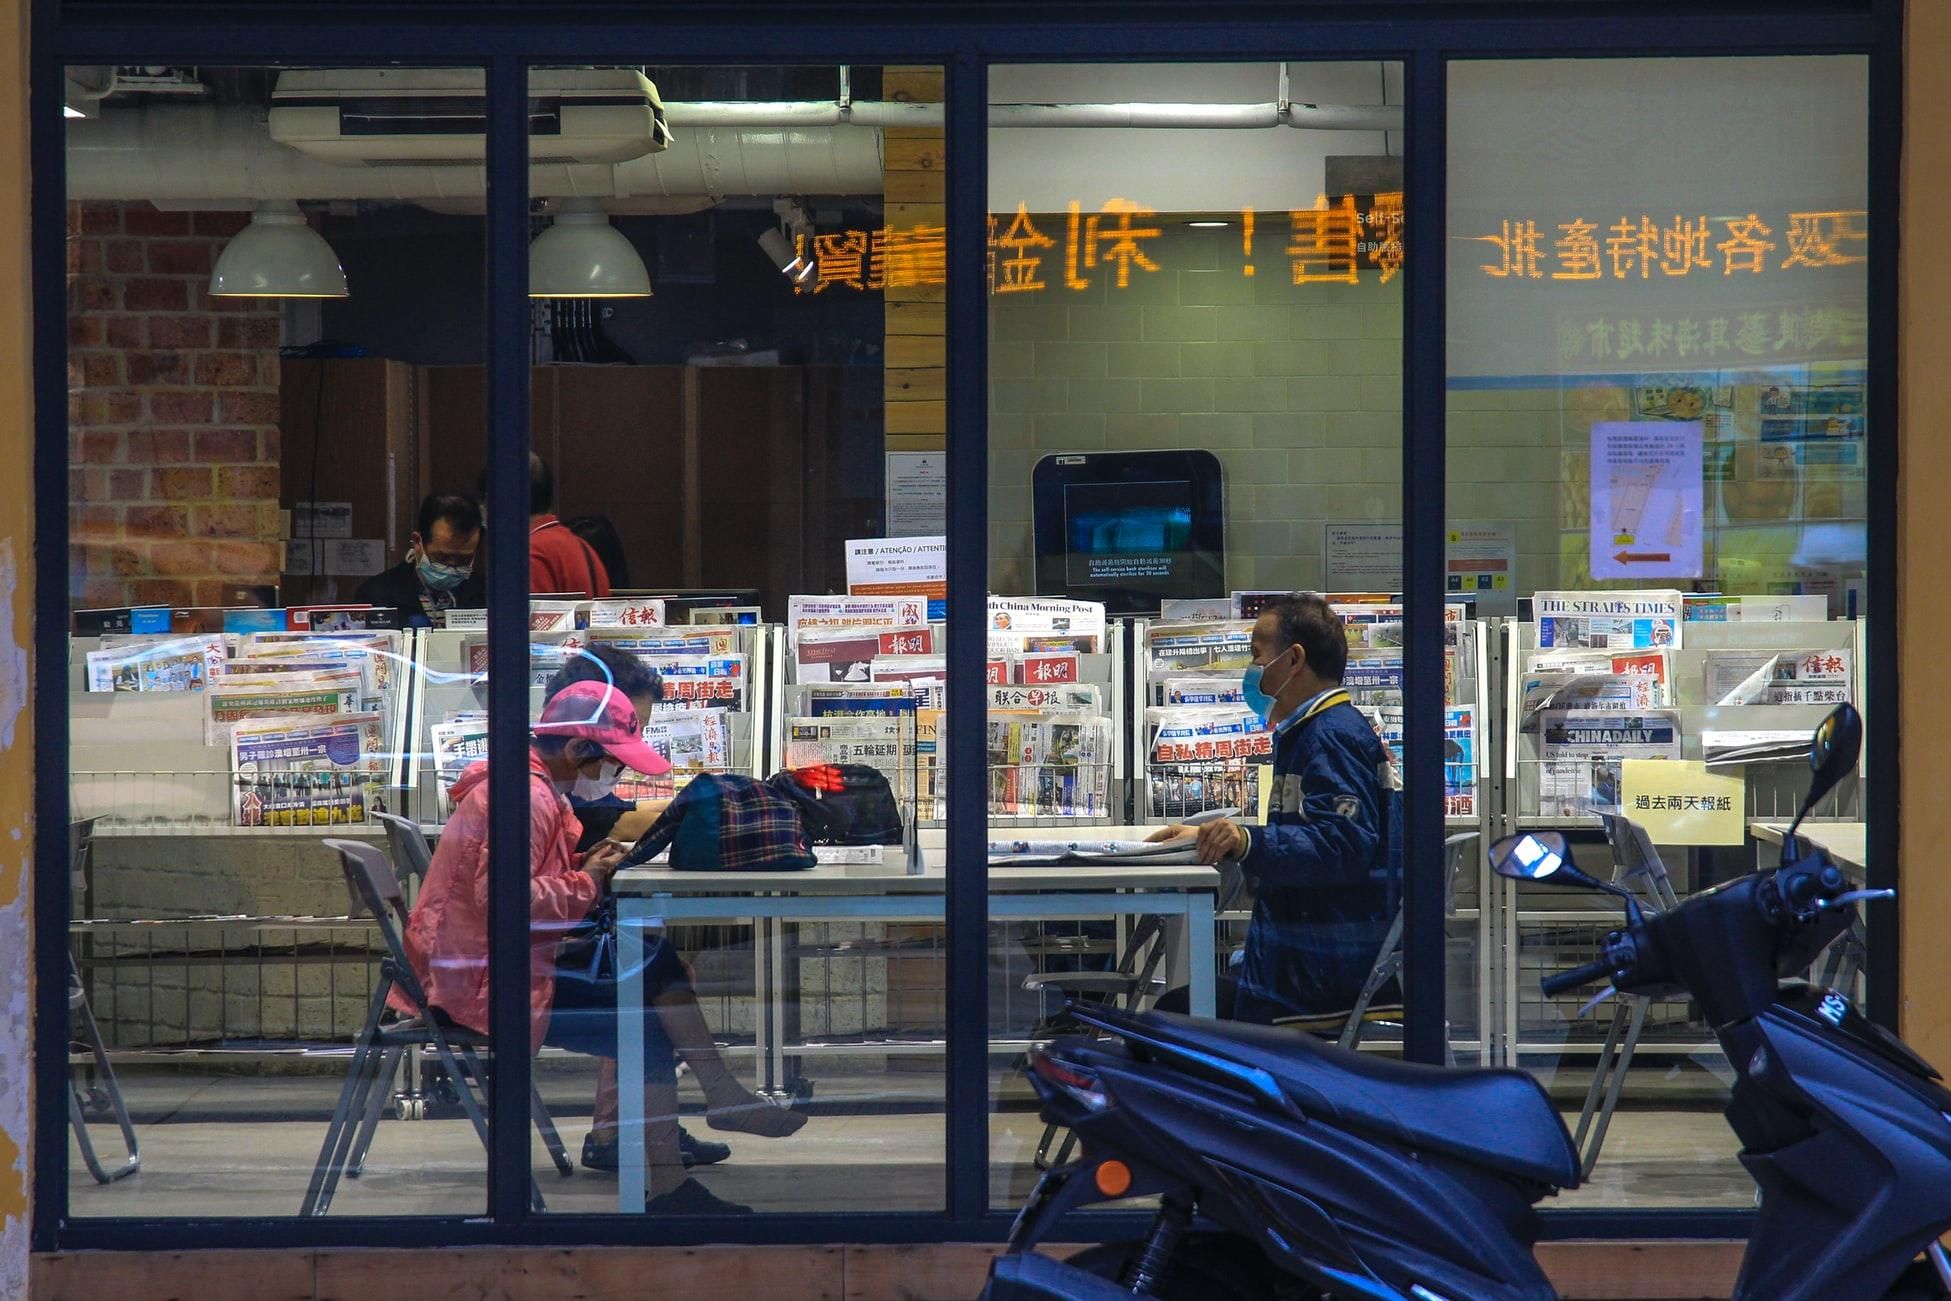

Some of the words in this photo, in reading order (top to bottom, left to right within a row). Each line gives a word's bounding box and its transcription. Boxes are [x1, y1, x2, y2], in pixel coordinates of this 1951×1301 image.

[880, 544, 912, 555] ATENÇÃO
[619, 606, 658, 625] 信報
[1000, 601, 1029, 611] China
[1031, 602, 1071, 614] Morning
[1072, 605, 1093, 613] Post
[1540, 600, 1570, 612] THE
[1572, 600, 1631, 613] STRAITS
[1633, 601, 1676, 614] TIMES
[1802, 654, 1845, 674] 信報
[1156, 736, 1273, 762] 自私精周街走
[1635, 794, 1732, 812] 過去兩天報紙
